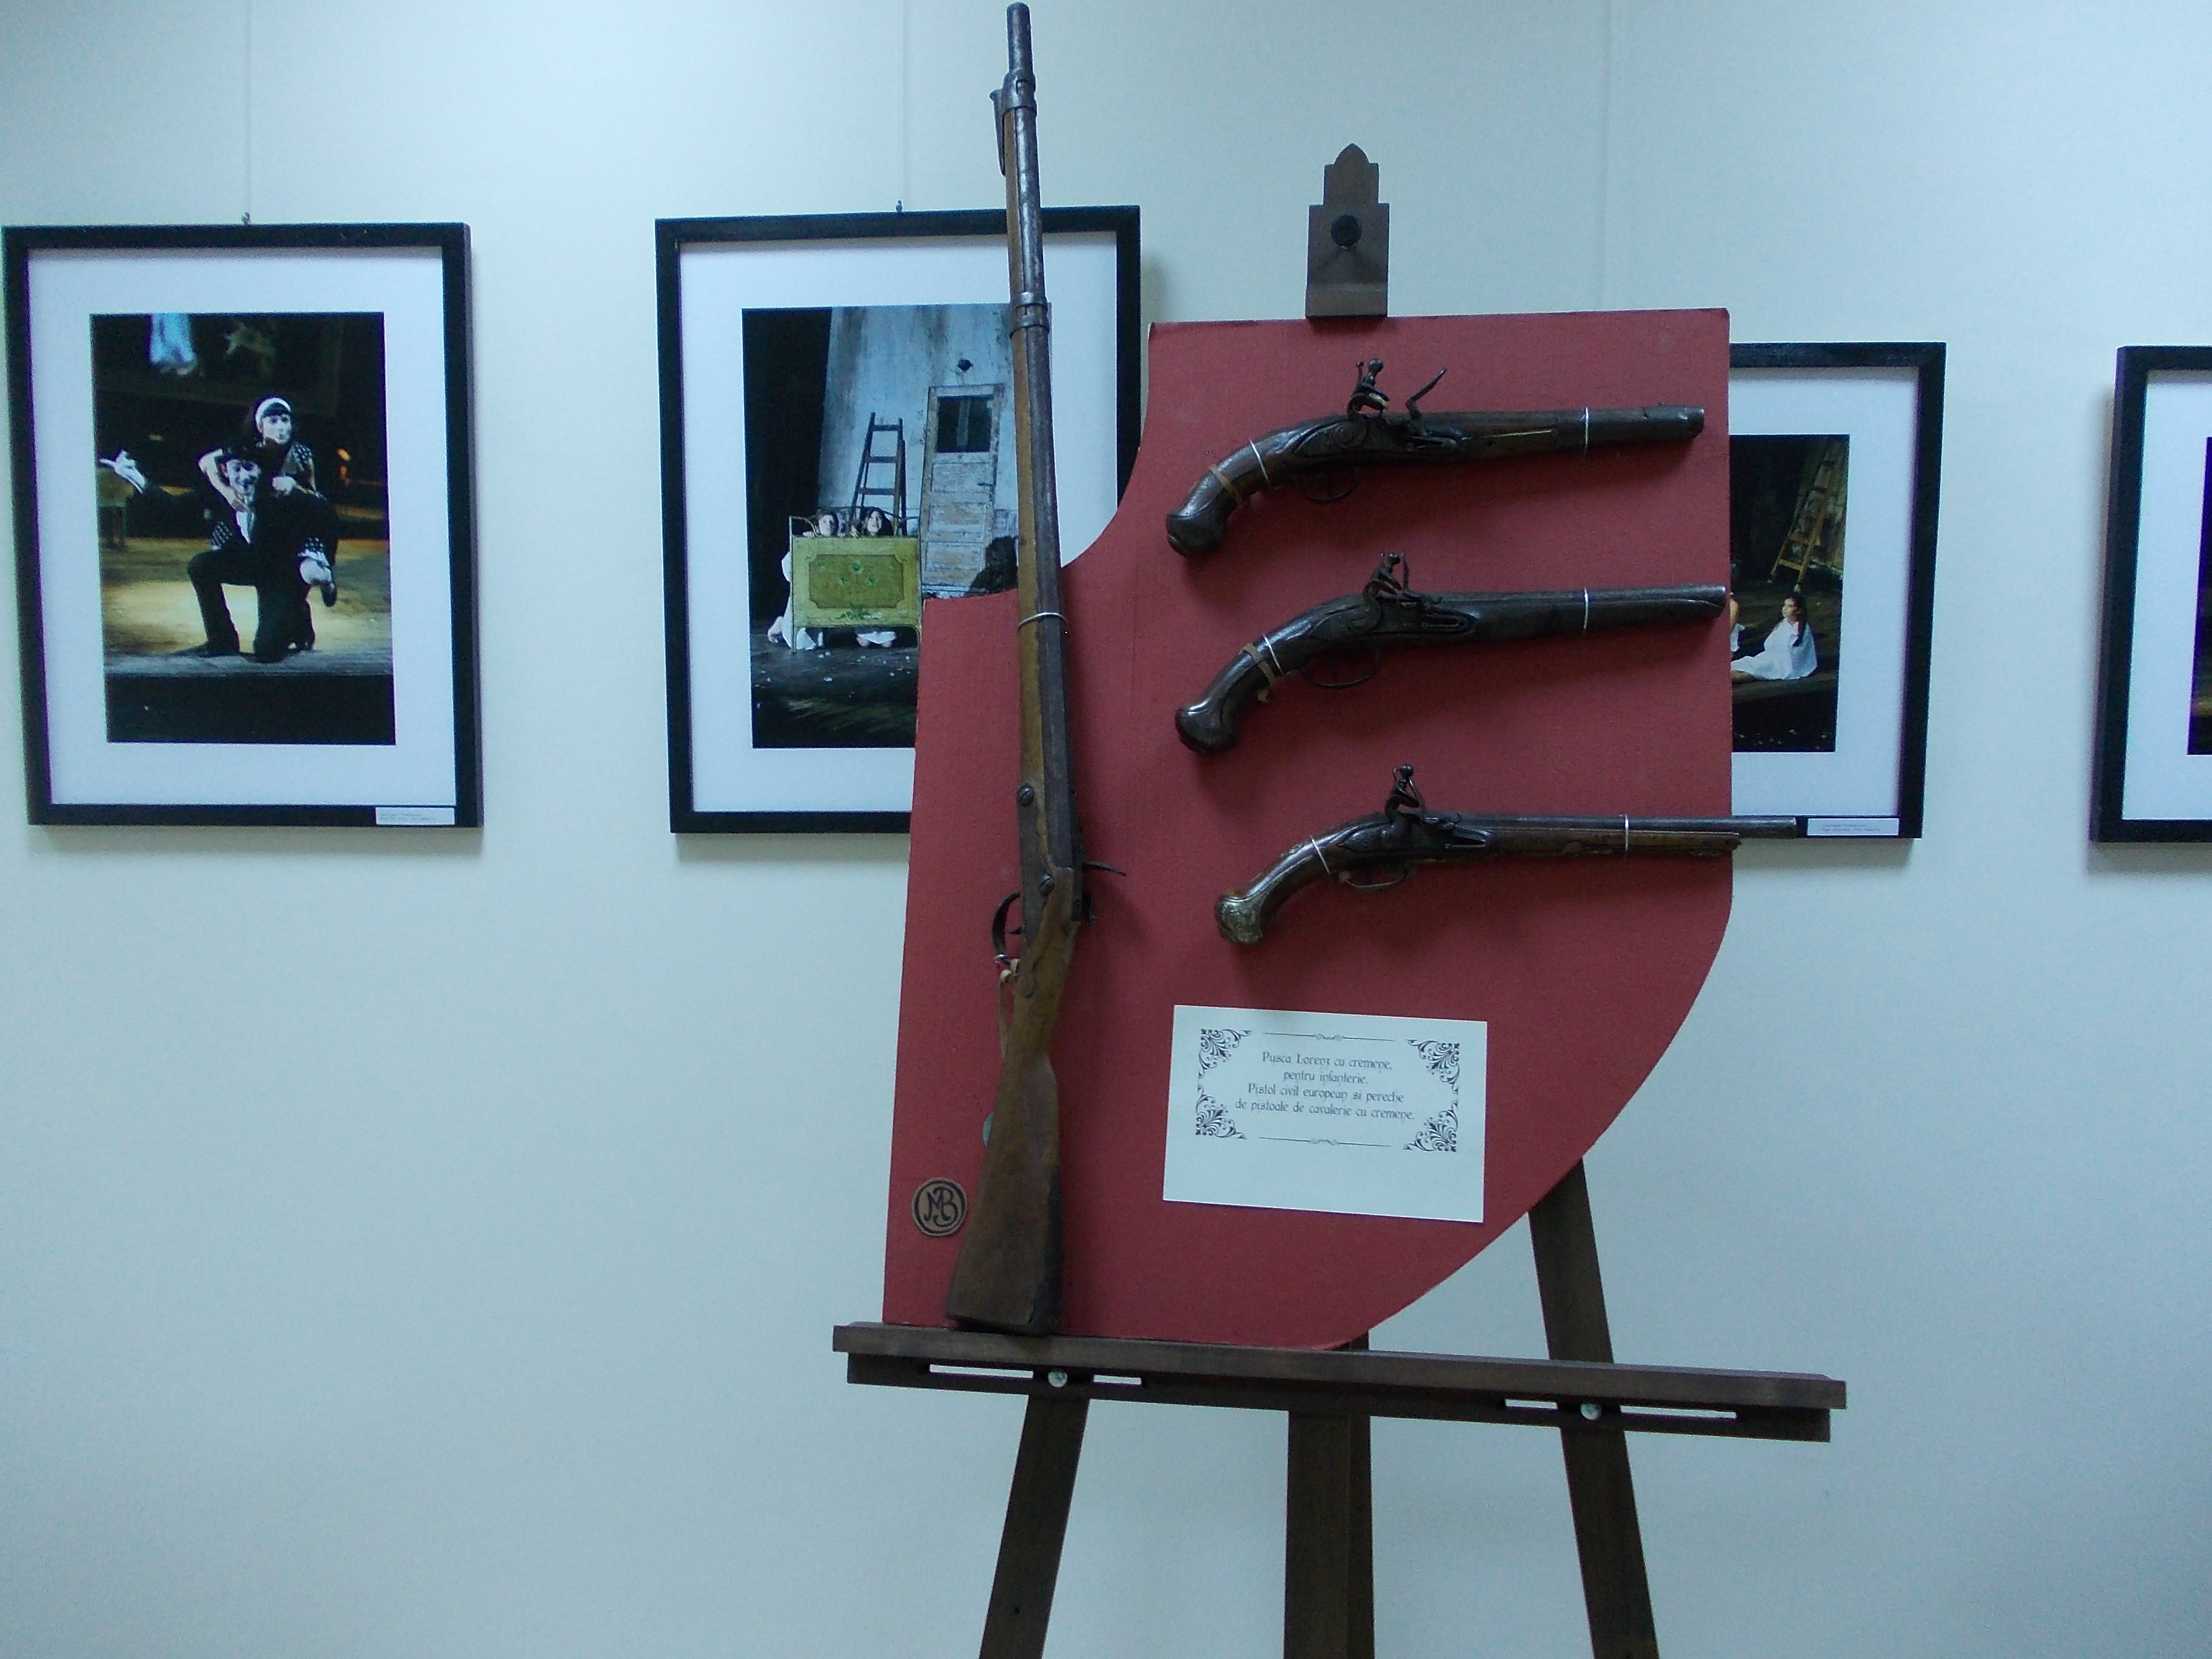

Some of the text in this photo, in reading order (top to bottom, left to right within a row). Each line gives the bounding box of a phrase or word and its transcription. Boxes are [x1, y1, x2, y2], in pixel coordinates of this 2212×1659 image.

[1262, 1051, 1292, 1064] Pusca
[1283, 1070, 1315, 1084] pentru
[1248, 1082, 1404, 1102] Pistol civil european si pereche
[1235, 1098, 1247, 1109] de
[1251, 1101, 1289, 1113] pistoale
[1293, 1101, 1305, 1112] de
[1309, 1104, 1352, 1116] cavalerie
[1371, 1110, 1415, 1123] cremene.
